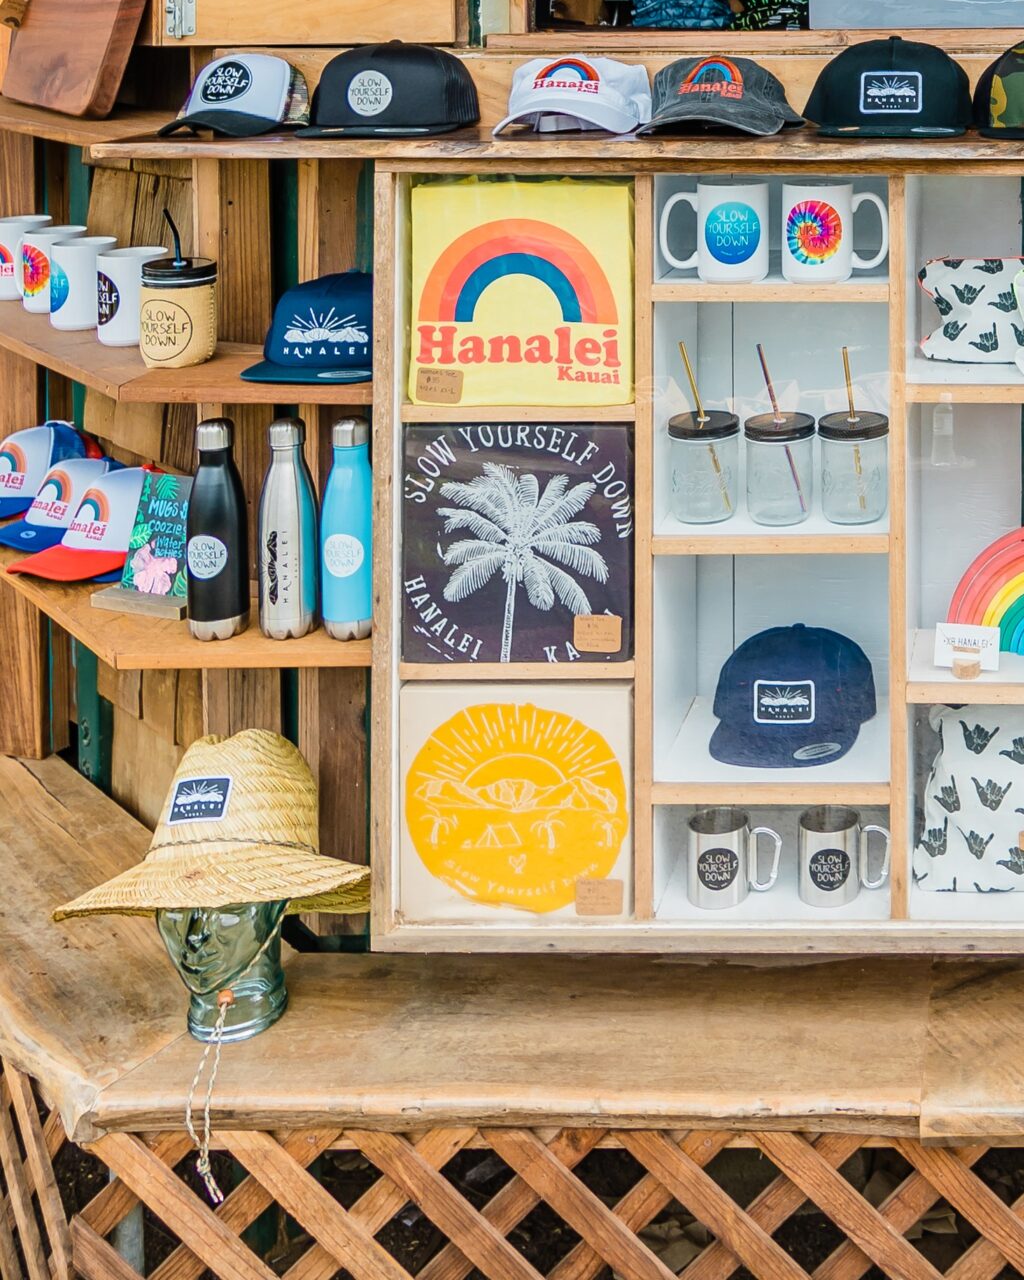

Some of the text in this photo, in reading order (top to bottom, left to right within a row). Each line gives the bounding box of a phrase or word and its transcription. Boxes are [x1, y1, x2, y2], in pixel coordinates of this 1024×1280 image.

[214, 66, 243, 78] SLOW
[205, 76, 249, 88] YOURSELF
[357, 78, 382, 88] SLOW
[532, 79, 599, 91] Hanalei
[678, 81, 743, 95] Hanalei
[207, 85, 236, 95] DOWN
[350, 87, 390, 98] YOURSELF
[356, 97, 382, 106] DOWN
[866, 97, 917, 106] HANALEI
[716, 209, 748, 223] SLOW
[707, 221, 758, 235] YOURSELF
[716, 234, 749, 248] DOWN
[144, 309, 176, 322] SLOW
[283, 346, 368, 359] HANALEI
[416, 325, 622, 368] Hanalei
[556, 365, 621, 385] Kauai
[404, 424, 634, 539] SLOW YOURSELF DOWN
[149, 499, 178, 518] MUGS
[193, 542, 216, 551] SLOW
[329, 541, 353, 550] SLOW
[404, 574, 484, 660] HANALEI
[958, 638, 989, 649] HANALEI
[759, 705, 810, 714] HANALEI
[706, 853, 730, 865] SLOW
[817, 853, 843, 864] SLOW
[698, 860, 738, 872] YOURSELF
[810, 860, 850, 872] YOURSELF
[704, 871, 731, 882] DOWN
[816, 871, 843, 883] DOWN
[487, 879, 557, 897] Yourself
